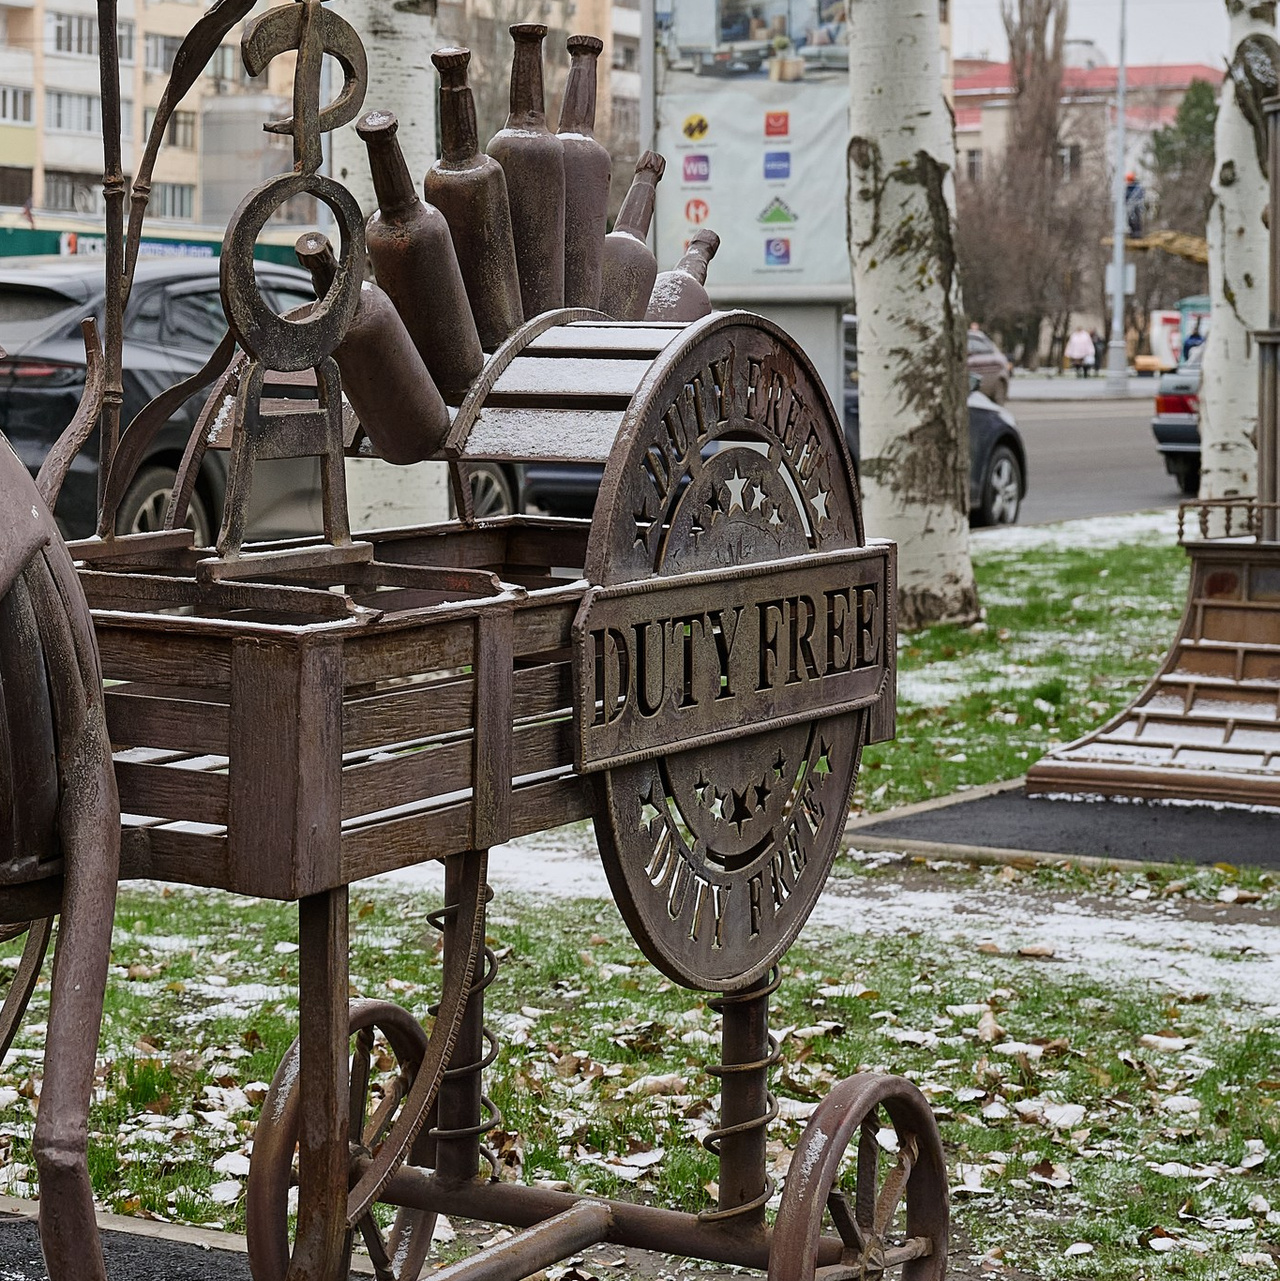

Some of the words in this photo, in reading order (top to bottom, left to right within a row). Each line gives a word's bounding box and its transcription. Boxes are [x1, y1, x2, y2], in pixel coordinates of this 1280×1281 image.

[640, 354, 734, 501] DUTY
[746, 354, 825, 489] FREE
[589, 605, 745, 728] DUTY
[753, 582, 881, 694] FREE
[644, 818, 733, 949] DUTY
[746, 778, 825, 942] FREE
